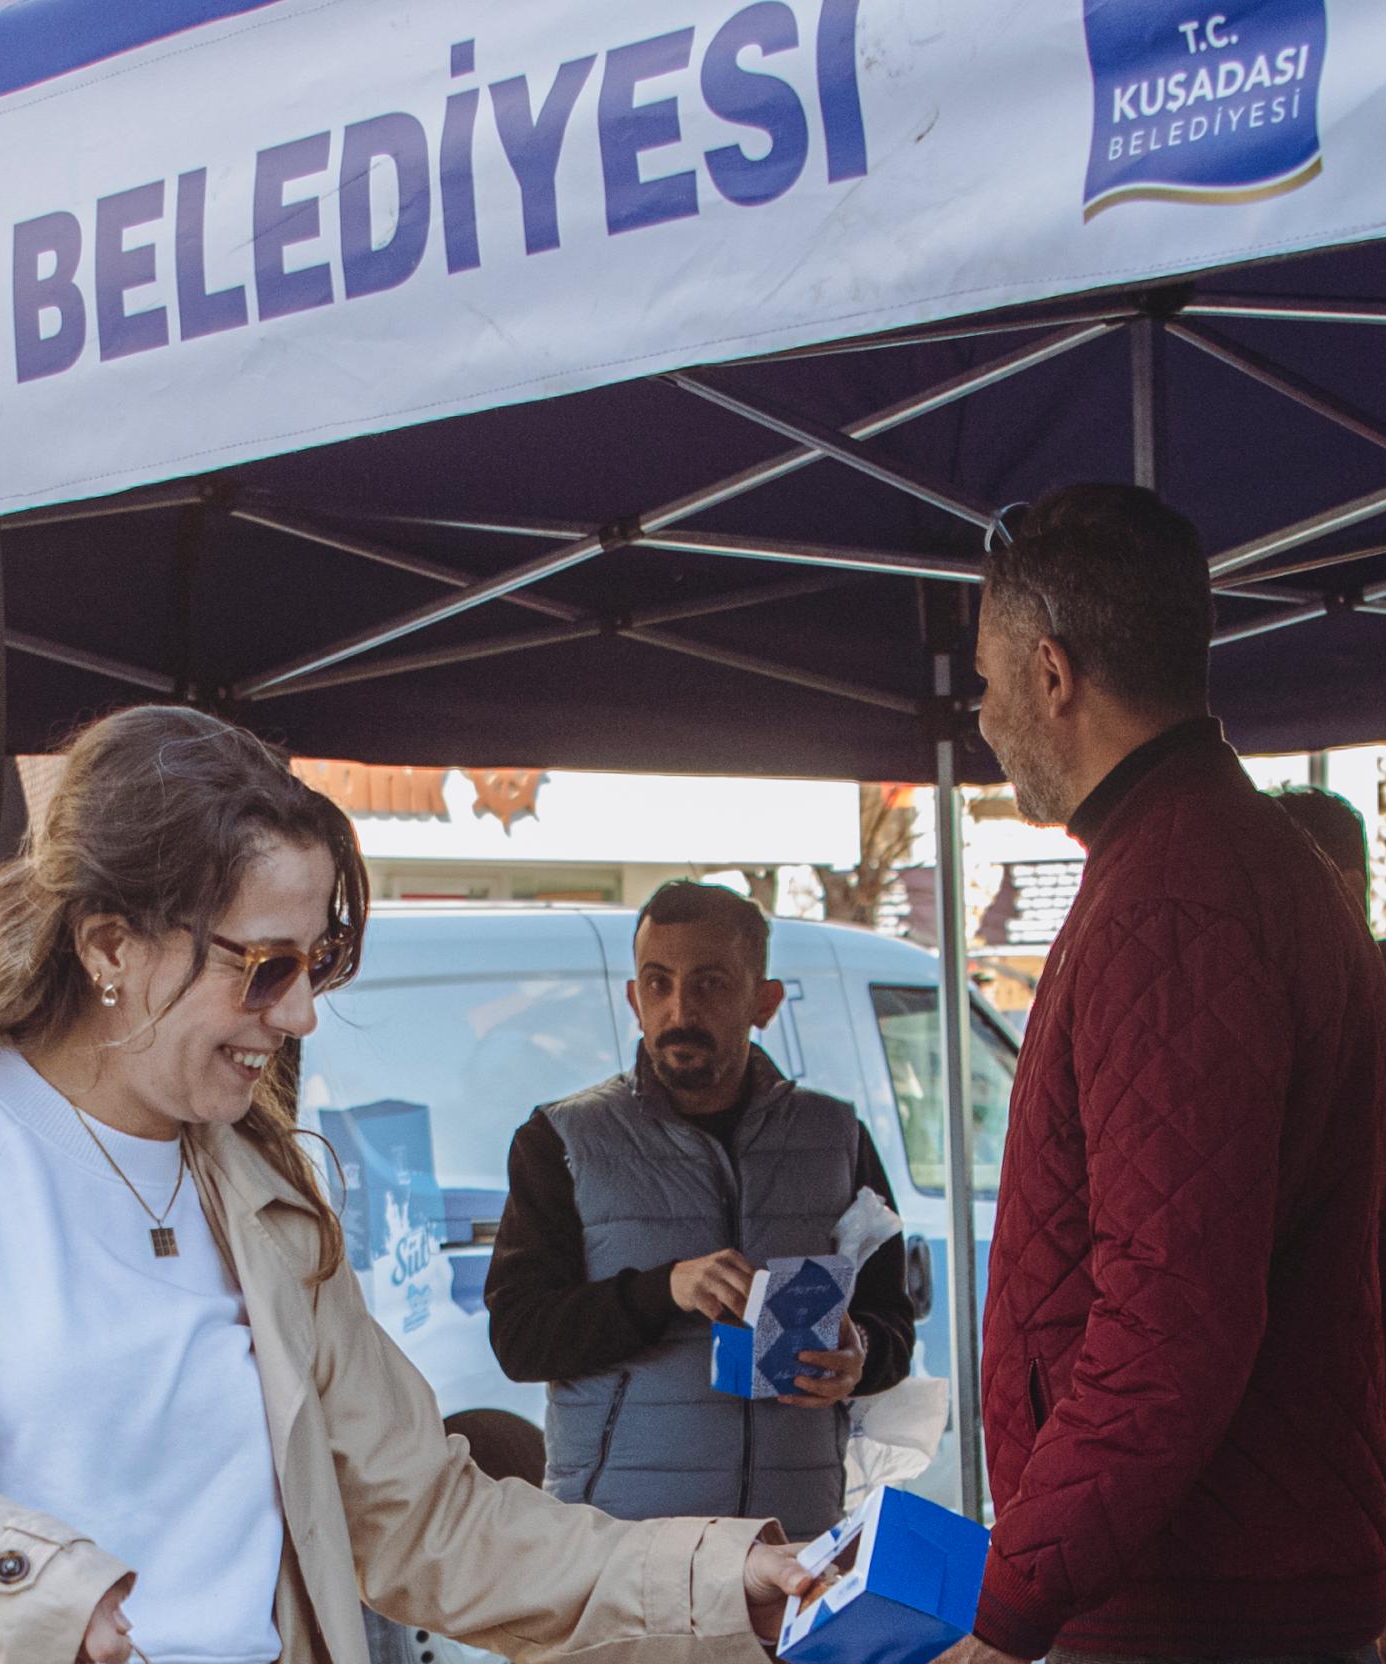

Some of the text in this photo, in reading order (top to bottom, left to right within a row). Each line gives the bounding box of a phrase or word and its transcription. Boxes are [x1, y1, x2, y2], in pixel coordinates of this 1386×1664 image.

[1178, 15, 1239, 54] T.C.
[1112, 44, 1310, 125] KUŞADASI
[1107, 88, 1302, 162] BELEDİYESİ
